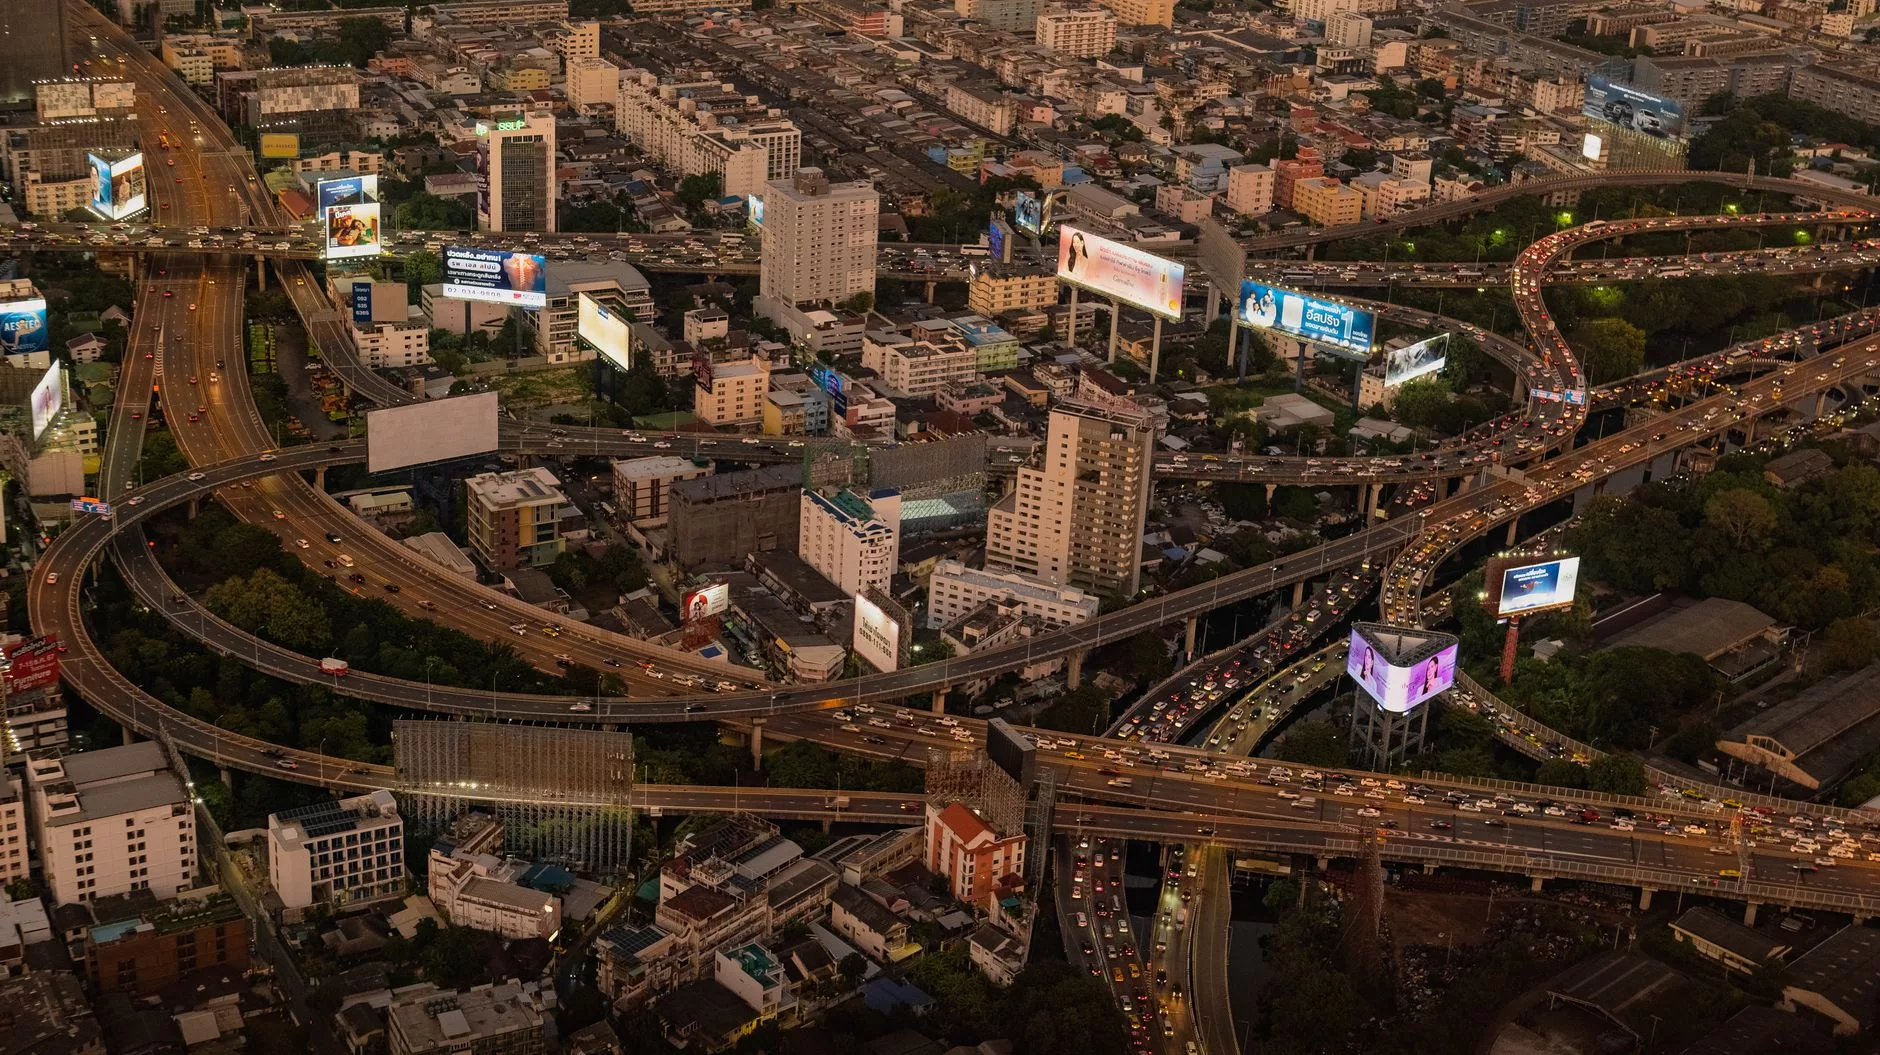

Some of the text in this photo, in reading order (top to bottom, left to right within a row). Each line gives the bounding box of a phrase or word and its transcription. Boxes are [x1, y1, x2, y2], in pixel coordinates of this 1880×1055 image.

[498, 121, 525, 131] SSUP
[1306, 309, 1354, 339] อีสปริง 1
[13, 670, 51, 687] Furniture
